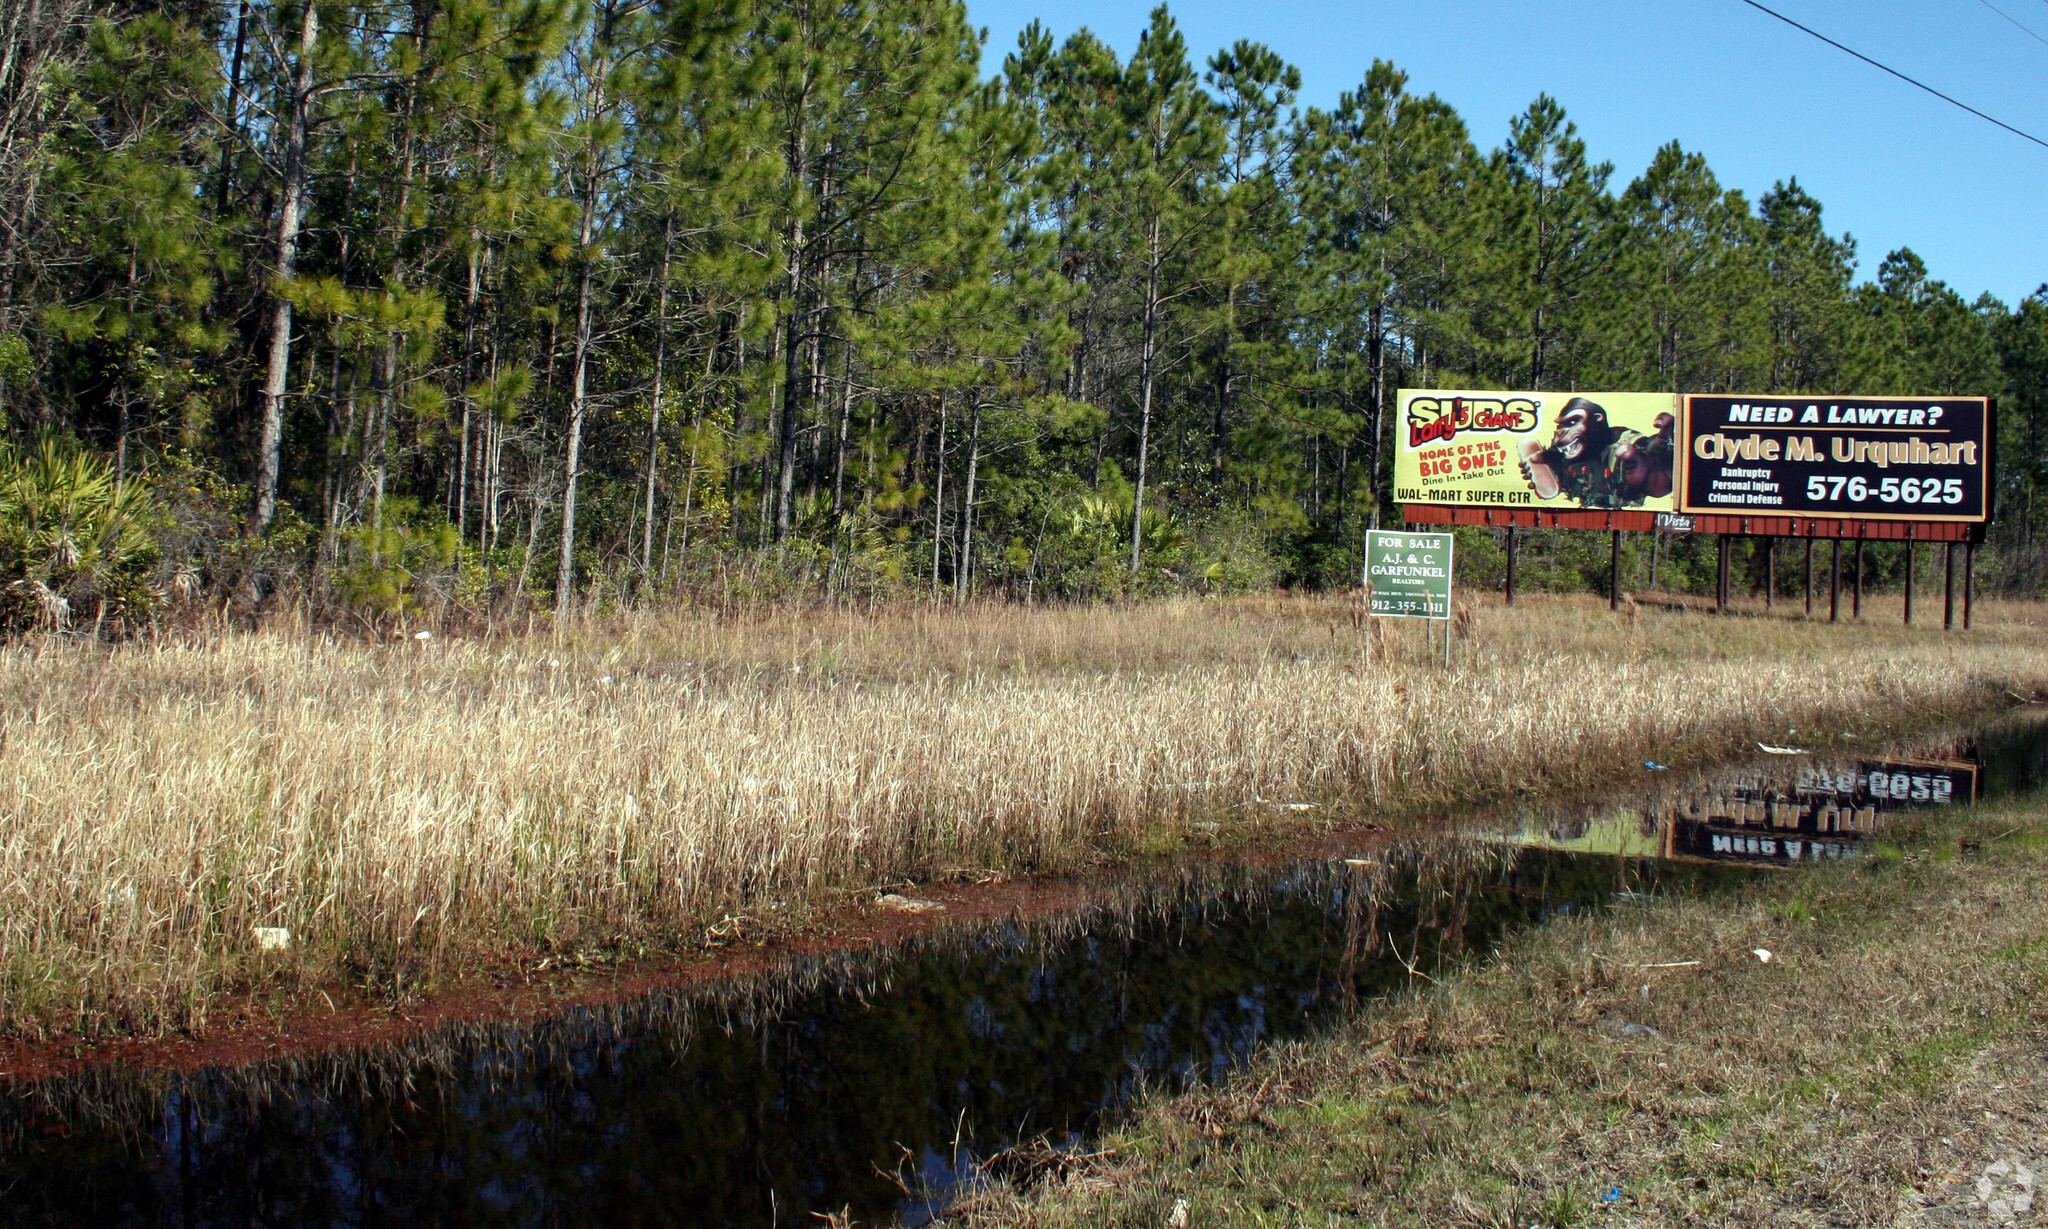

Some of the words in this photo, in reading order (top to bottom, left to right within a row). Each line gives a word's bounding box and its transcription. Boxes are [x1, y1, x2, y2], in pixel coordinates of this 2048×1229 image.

[1407, 397, 1538, 432] SUBS
[1475, 412, 1522, 427] GIANT
[1728, 404, 1794, 423] NEED
[1800, 405, 1819, 423] A
[1827, 405, 1943, 426] LAWYER?
[1410, 398, 1469, 447] Larry's
[1419, 447, 1454, 461] HOME
[1457, 445, 1473, 455] OF
[1476, 441, 1501, 452] THE
[1694, 433, 1780, 464] Clyde
[1785, 436, 1824, 462] M.
[1831, 436, 1977, 468] Urquhart
[1419, 459, 1453, 477] BIG
[1458, 450, 1507, 471] ONE!
[1422, 476, 1444, 486] Dine
[1446, 475, 1456, 483] In
[1462, 471, 1484, 480] Take
[1487, 468, 1505, 476] Out
[1721, 467, 1771, 479] Bankruptcy
[1712, 480, 1750, 491] Personal
[1752, 481, 1779, 493] Injury
[1806, 475, 1963, 504] 576-5625
[1397, 488, 1462, 502] WAL-MART
[1466, 490, 1504, 503] SUPER
[1508, 491, 1531, 503] CTR
[1708, 493, 1745, 504] Criminal
[1746, 494, 1783, 505] Defense
[1661, 514, 1690, 527] Vista
[1378, 537, 1403, 548] FOR
[1409, 538, 1441, 549] SALE
[1382, 553, 1403, 564] A.J.
[1406, 553, 1418, 564] &
[1423, 554, 1435, 564] C.
[1371, 565, 1445, 577] GARFUNKEL
[1371, 600, 1443, 612] 912-355-1311
